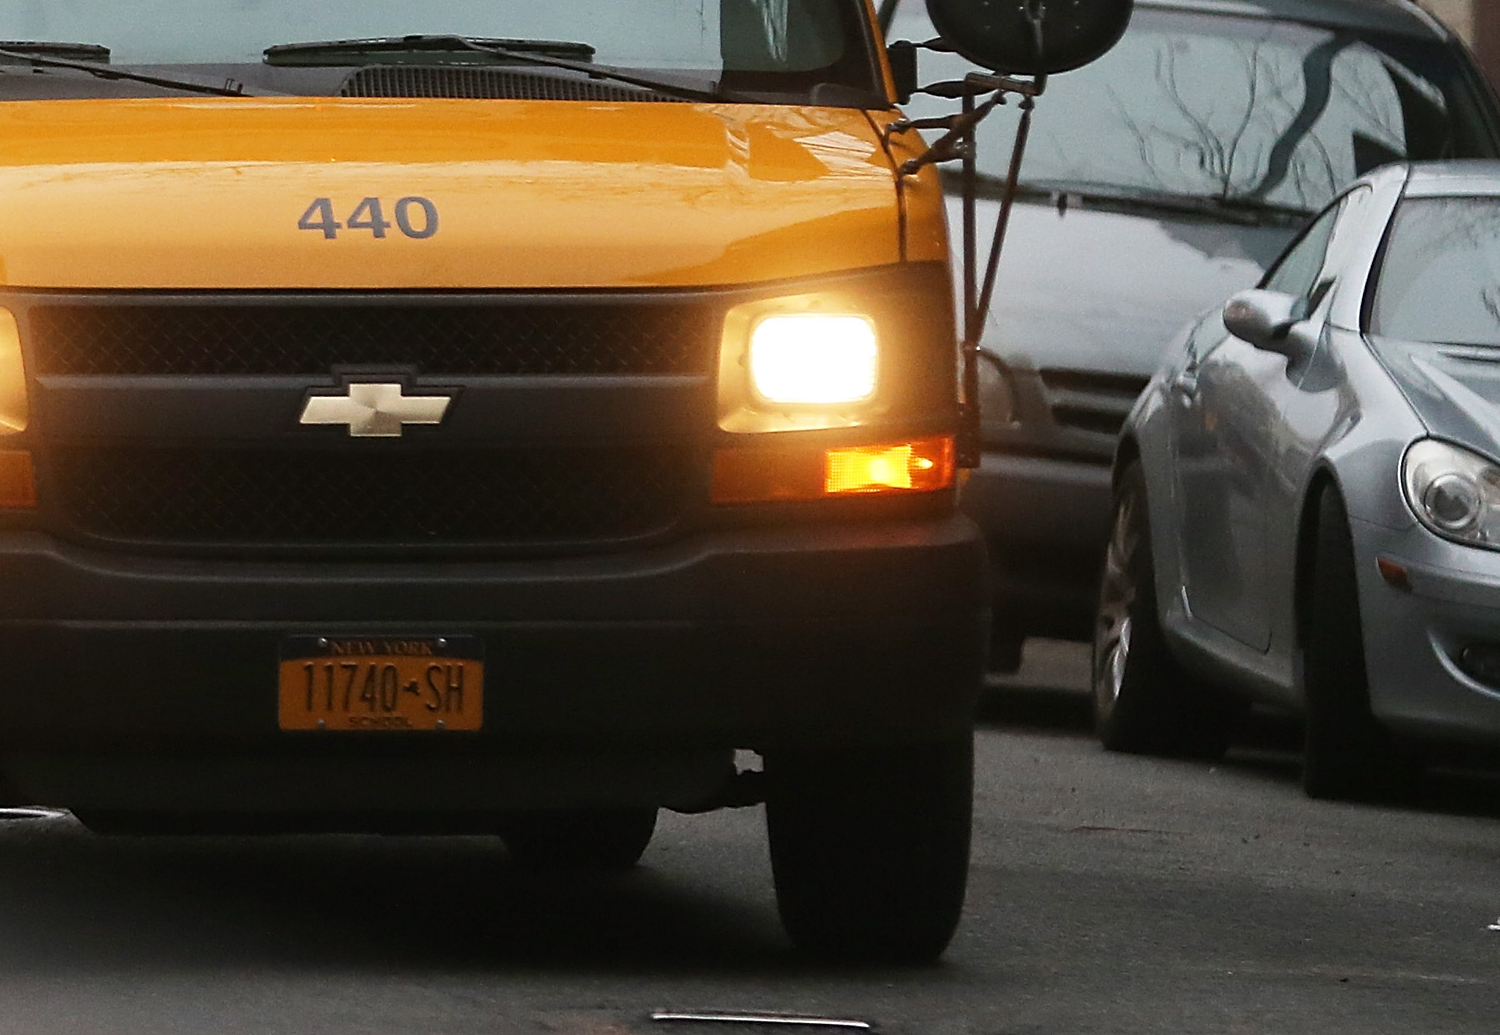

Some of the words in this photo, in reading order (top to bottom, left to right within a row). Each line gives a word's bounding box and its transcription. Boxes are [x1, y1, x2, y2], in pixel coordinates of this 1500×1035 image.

[297, 196, 440, 240] 440
[332, 640, 375, 655] NEW
[382, 640, 434, 655] YORK
